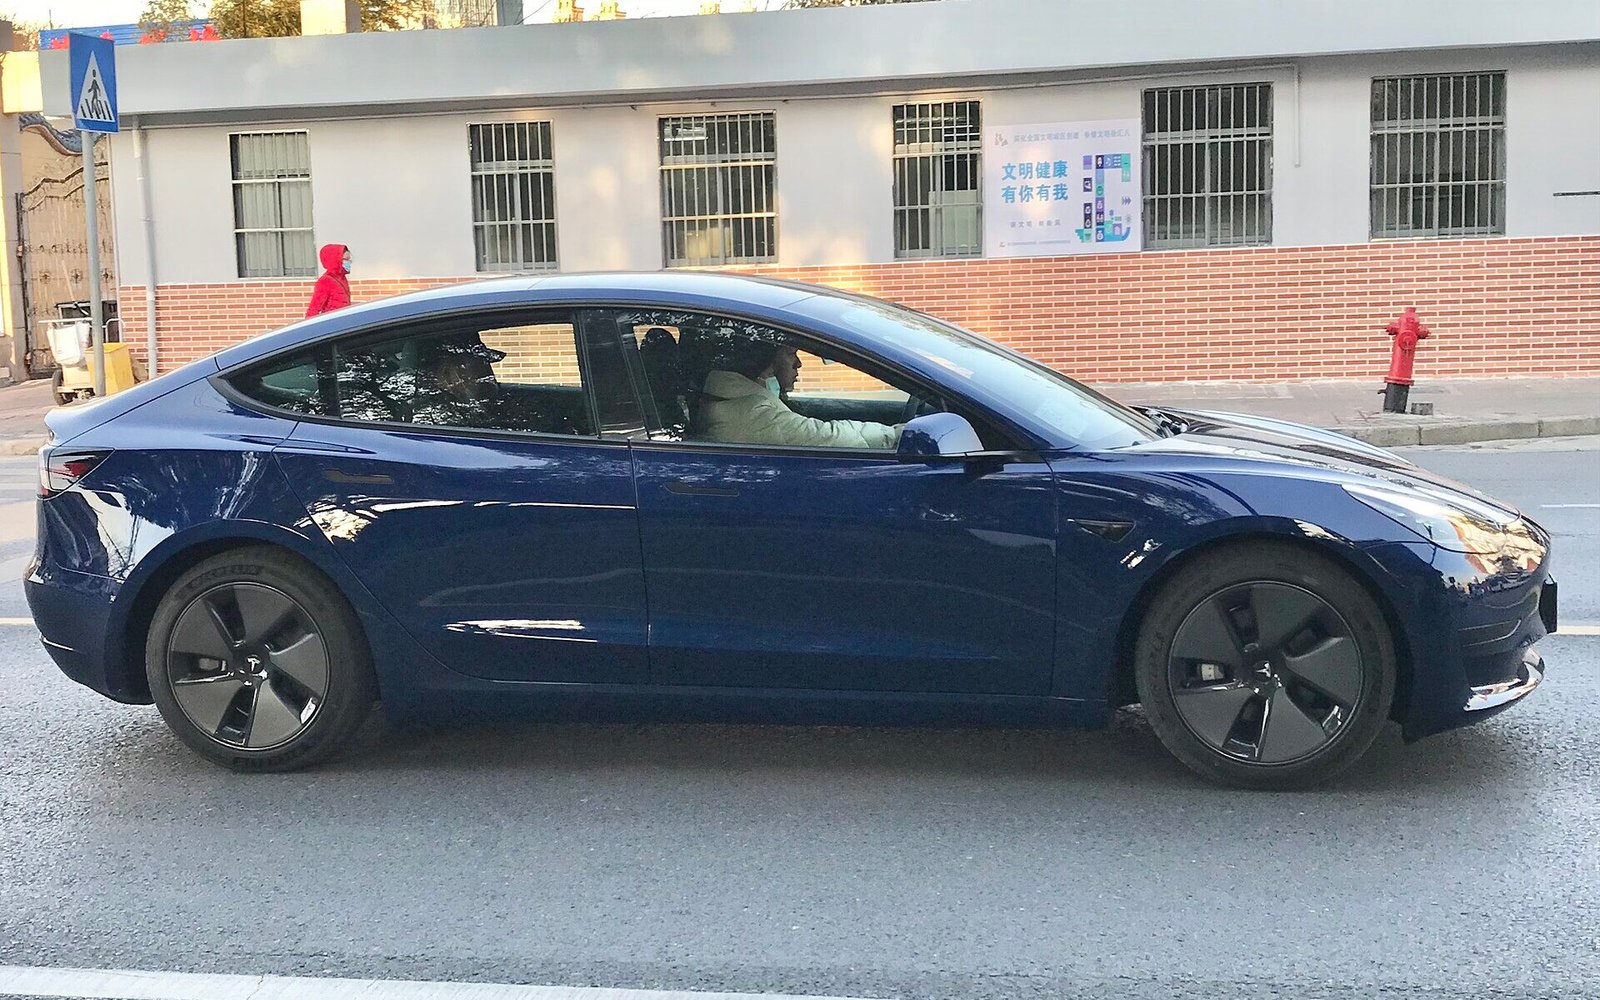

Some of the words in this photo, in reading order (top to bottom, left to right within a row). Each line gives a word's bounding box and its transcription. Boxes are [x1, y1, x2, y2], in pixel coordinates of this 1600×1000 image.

[1002, 160, 1068, 180] 文明健康
[1002, 183, 1068, 204] 有你有我
